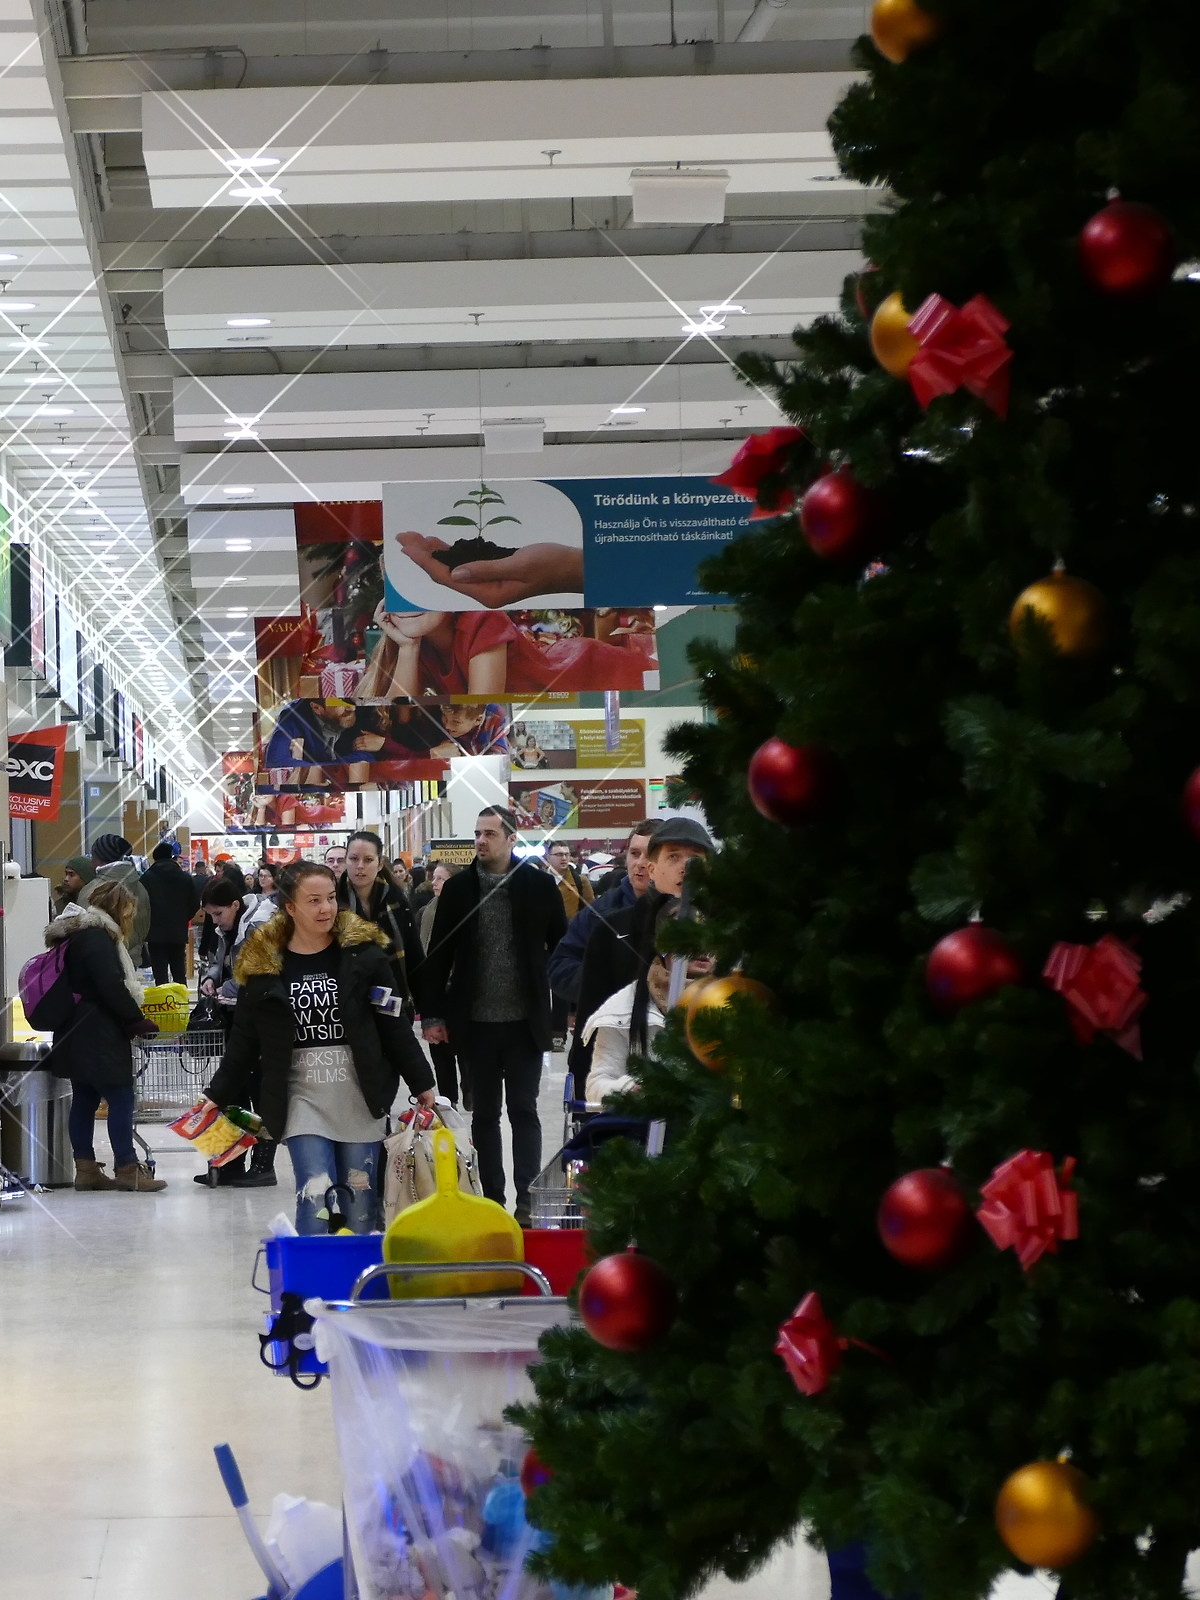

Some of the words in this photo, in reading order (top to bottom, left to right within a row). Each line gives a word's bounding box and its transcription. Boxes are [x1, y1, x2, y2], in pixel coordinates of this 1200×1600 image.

[593, 493, 659, 507] Törődünk
[662, 496, 670, 505] a
[594, 518, 640, 531] Használja
[642, 517, 658, 528] Ön
[660, 518, 667, 528] is
[670, 516, 737, 528] visszaváltható
[739, 516, 750, 527] és
[594, 532, 679, 545] újrahasznosítható
[681, 530, 734, 542] táskáinkat!
[6, 757, 55, 781] exc
[290, 978, 338, 996] PARIS
[294, 1023, 346, 1042] UTSID
[291, 1050, 353, 1068] ACKSTA
